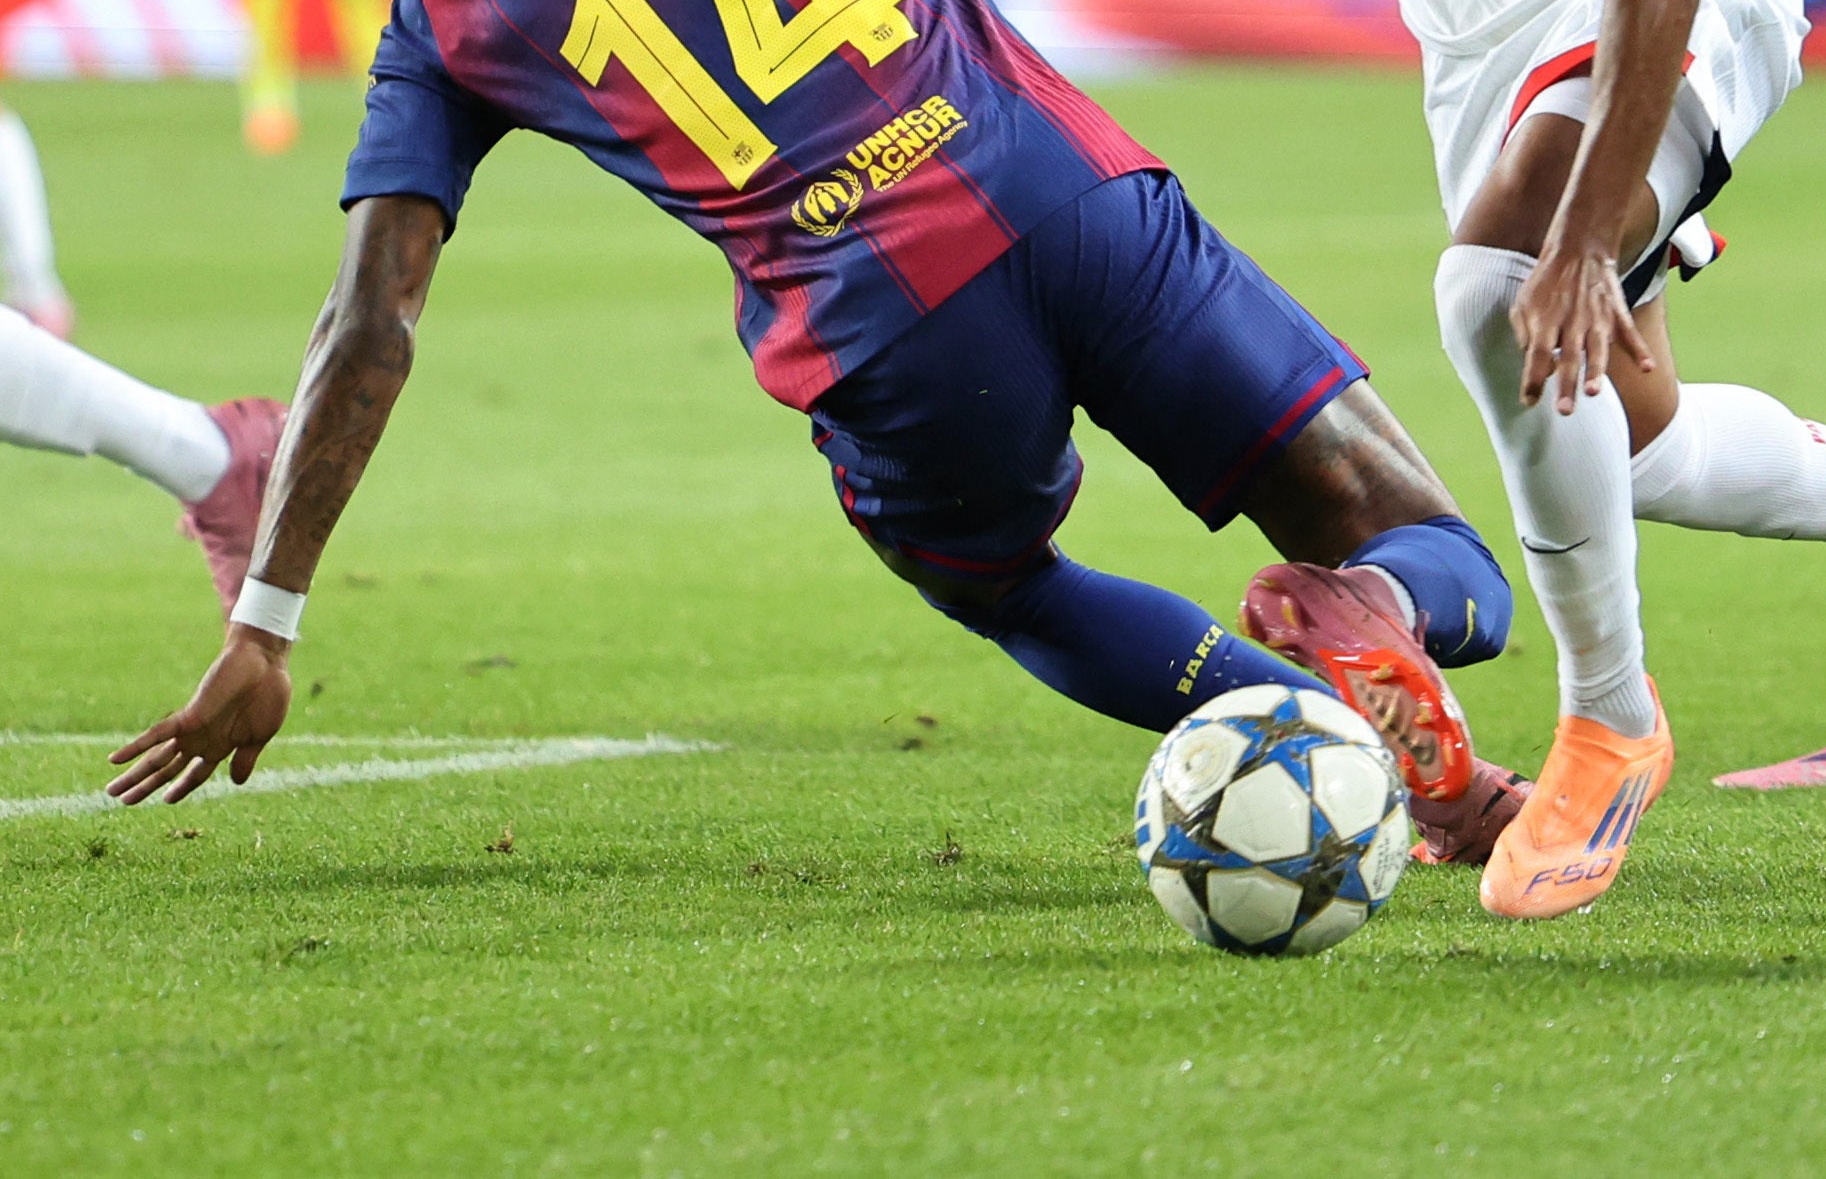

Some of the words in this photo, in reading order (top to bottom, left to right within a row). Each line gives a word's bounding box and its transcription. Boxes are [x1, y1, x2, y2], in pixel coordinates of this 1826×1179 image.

[845, 95, 948, 170] UNHCR
[867, 104, 964, 191] ACNUR
[893, 167, 908, 183] UN
[905, 142, 940, 173] Refugee
[937, 120, 968, 145] Agency
[1175, 624, 1225, 696] BARÇA
[1523, 857, 1613, 896] F50
